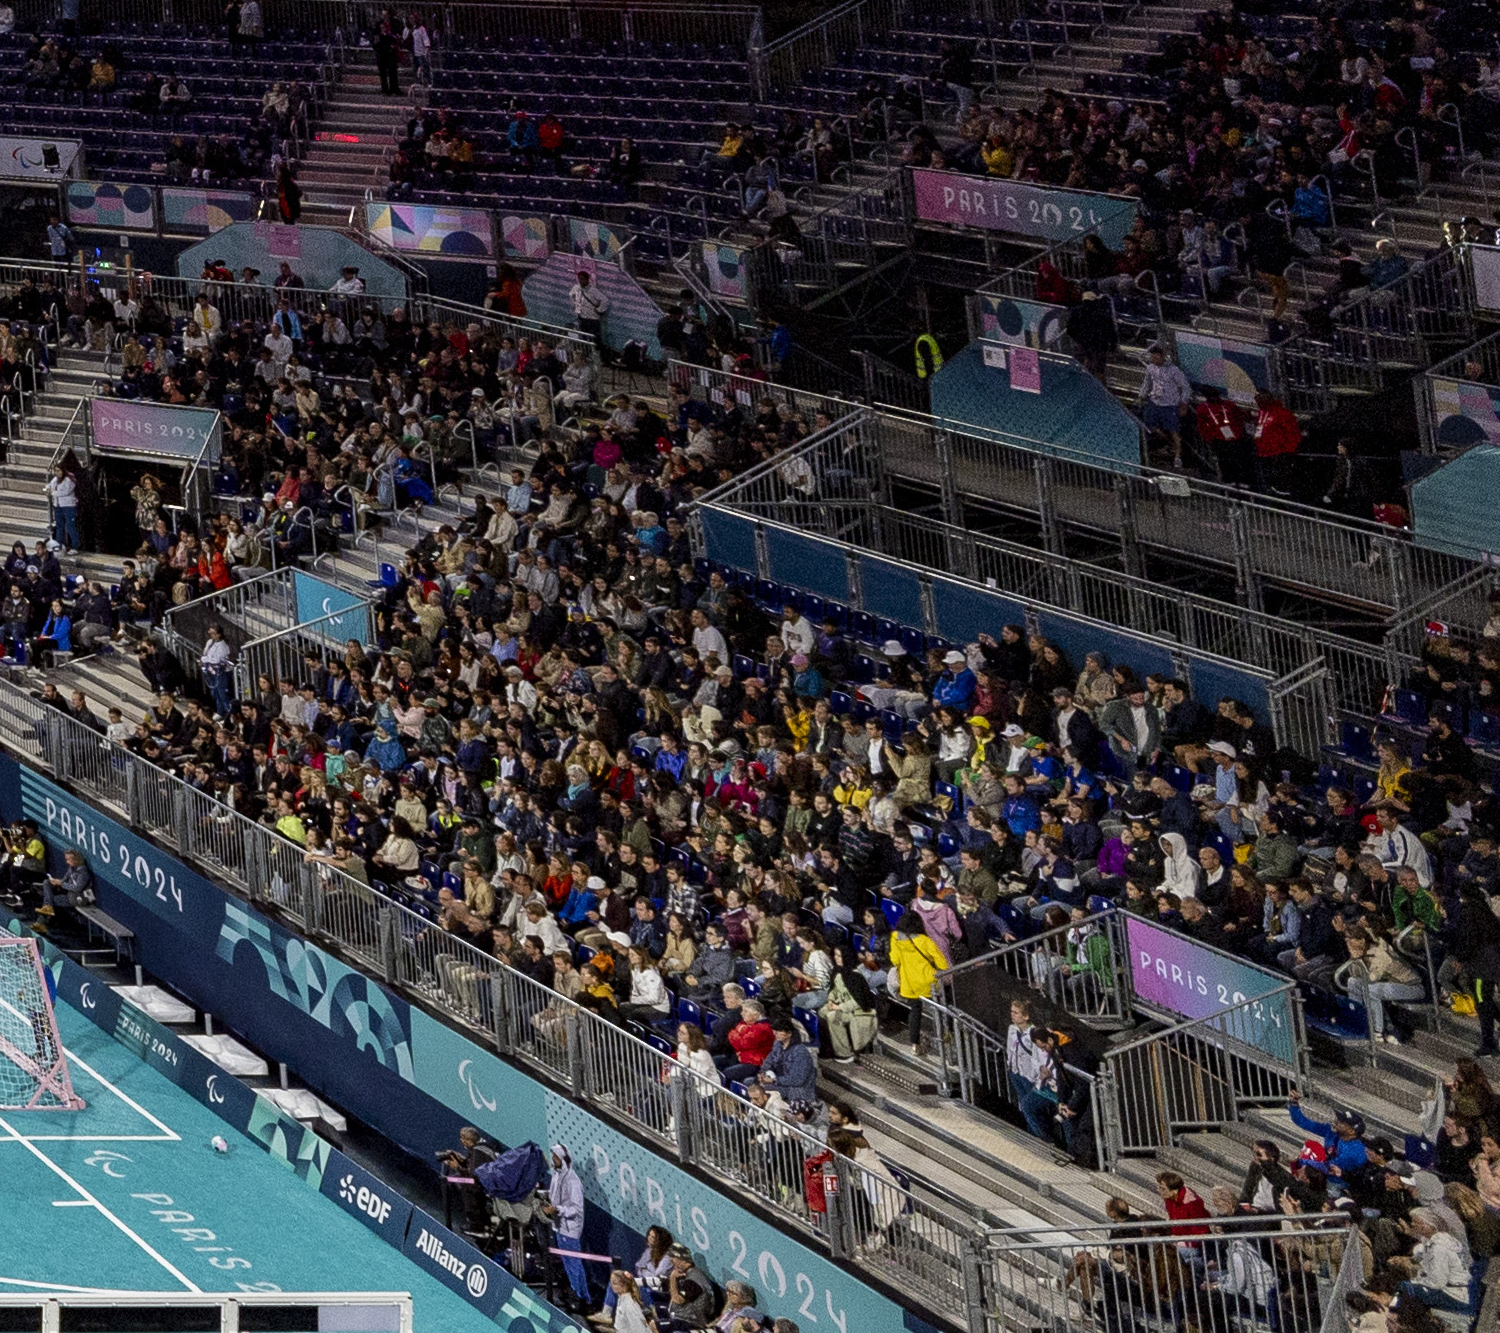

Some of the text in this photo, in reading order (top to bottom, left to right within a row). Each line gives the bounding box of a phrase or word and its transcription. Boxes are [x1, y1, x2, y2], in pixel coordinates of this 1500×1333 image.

[160, 425, 208, 440] 2024
[119, 844, 183, 912] 2024
[1217, 985, 1281, 1028] 2024
[151, 1039, 178, 1066] 2024
[416, 1229, 467, 1280] Allianz
[729, 1231, 847, 1333] 2024
